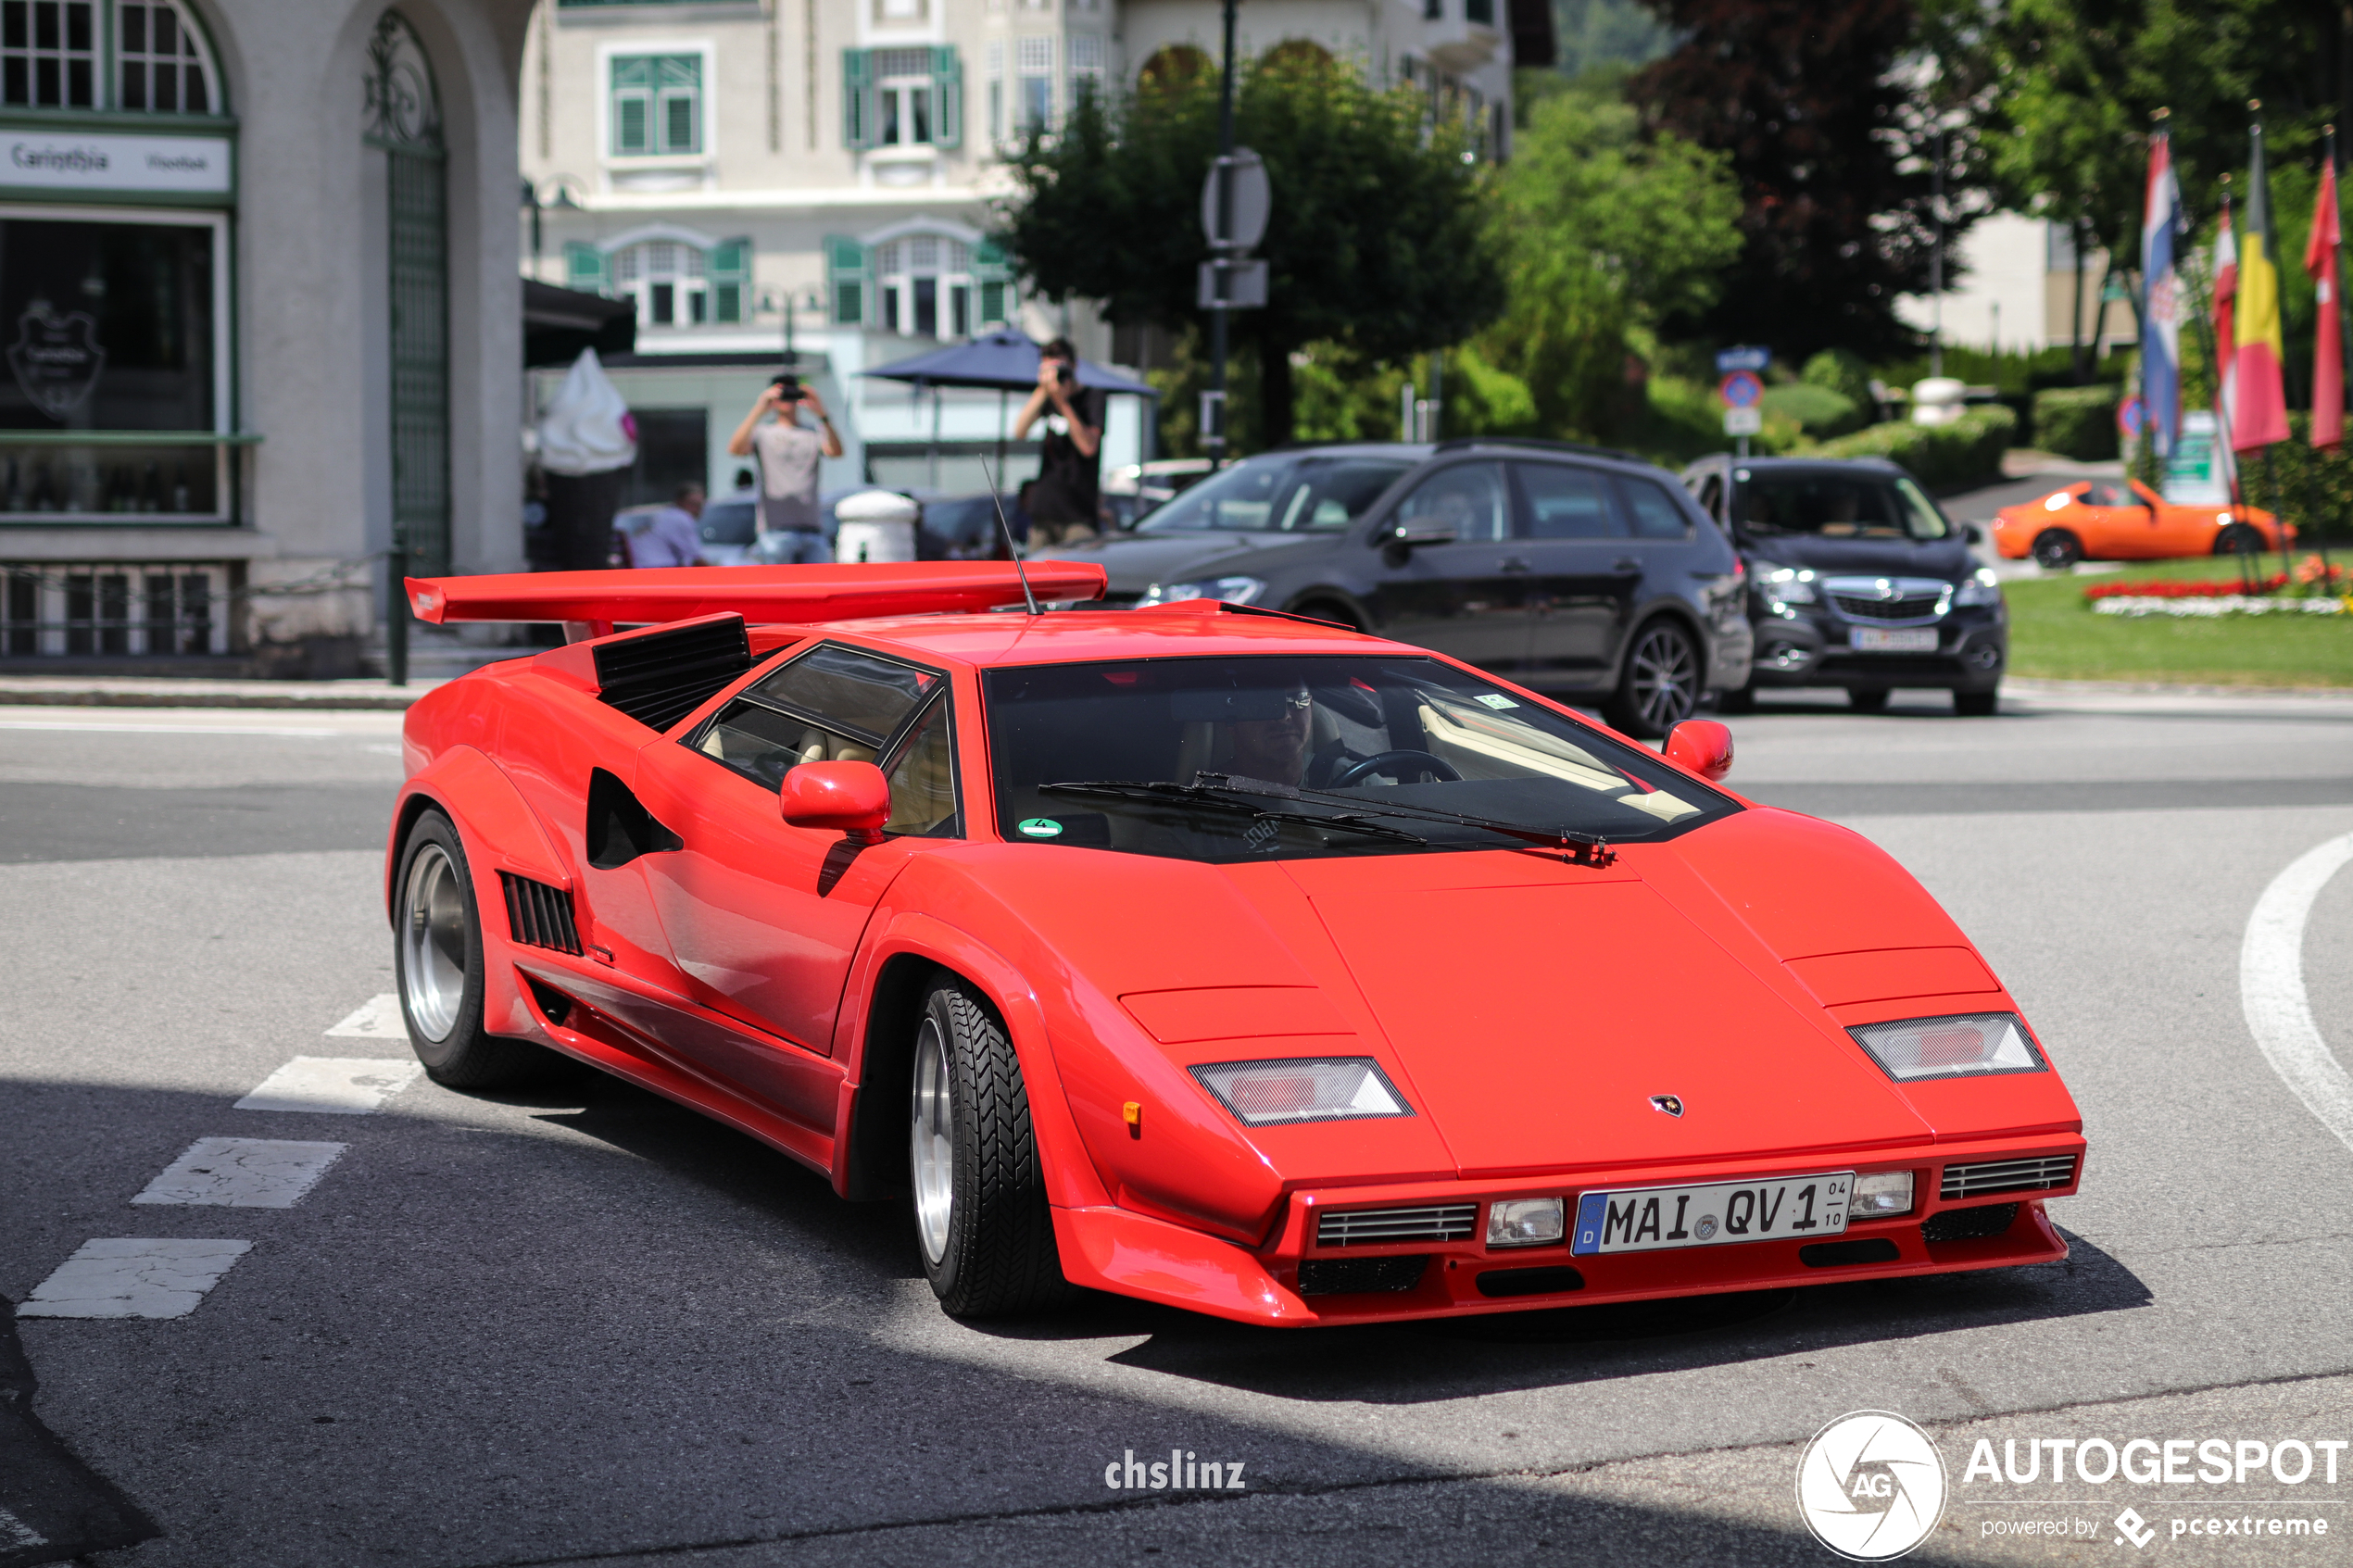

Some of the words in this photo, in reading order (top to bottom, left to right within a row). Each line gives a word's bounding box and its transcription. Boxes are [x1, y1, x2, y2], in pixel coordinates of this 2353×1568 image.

[12, 143, 109, 172] Carinthia
[1035, 819, 1048, 828] 4
[948, 1052, 961, 1123] PIRELLI
[1829, 1182, 1846, 1196] 04
[1583, 1231, 1593, 1245] D
[1603, 1195, 1691, 1245] MAI
[1725, 1186, 1785, 1236] QV
[1792, 1184, 1818, 1231] 1
[1825, 1213, 1842, 1227] 10
